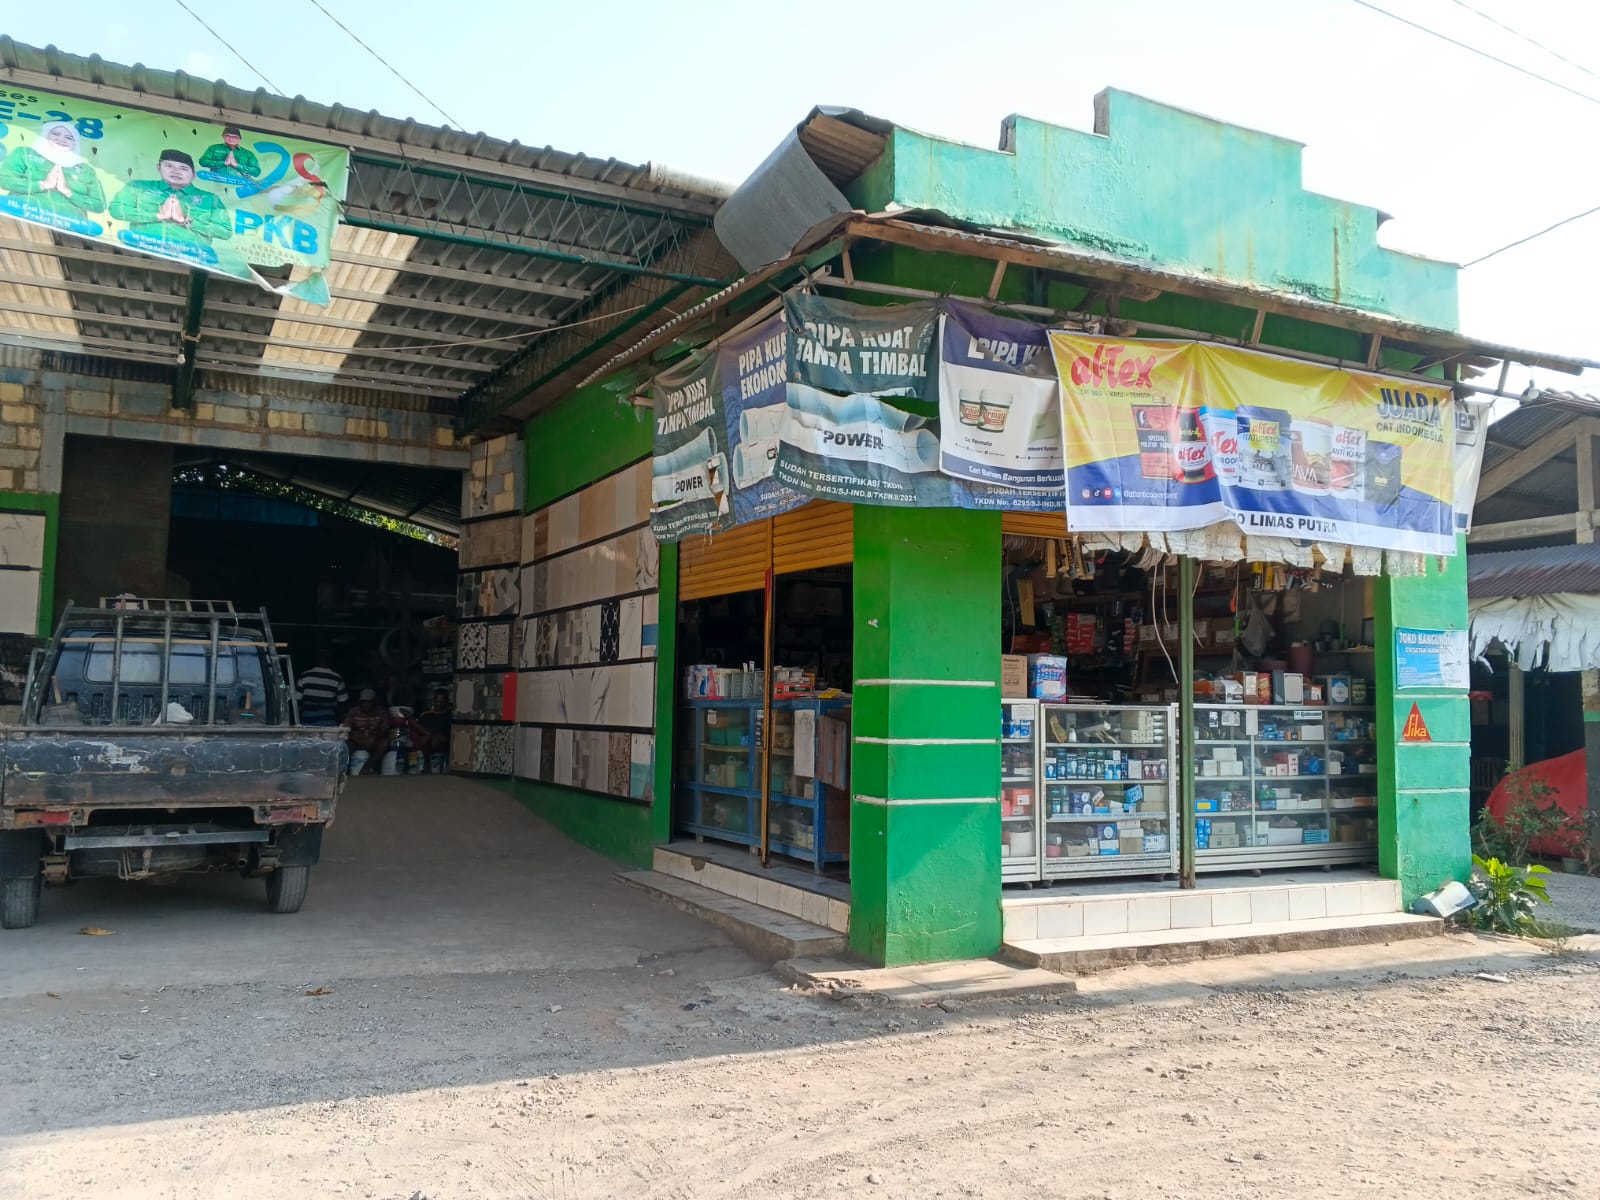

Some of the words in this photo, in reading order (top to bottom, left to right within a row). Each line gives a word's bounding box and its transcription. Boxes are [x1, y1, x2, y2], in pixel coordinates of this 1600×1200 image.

[235, 208, 318, 255] PKB
[739, 345, 763, 376] PIPA
[859, 351, 927, 377] TIMBAL
[823, 430, 884, 450] POWER
[1375, 421, 1394, 433] CAT
[1396, 424, 1444, 443] INDONESIA
[780, 459, 807, 477] SUDAH
[675, 475, 704, 494] POWER
[1250, 513, 1295, 530] LIMAS
[1298, 517, 1338, 534] PUTRA
[1403, 713, 1428, 738] Sika
